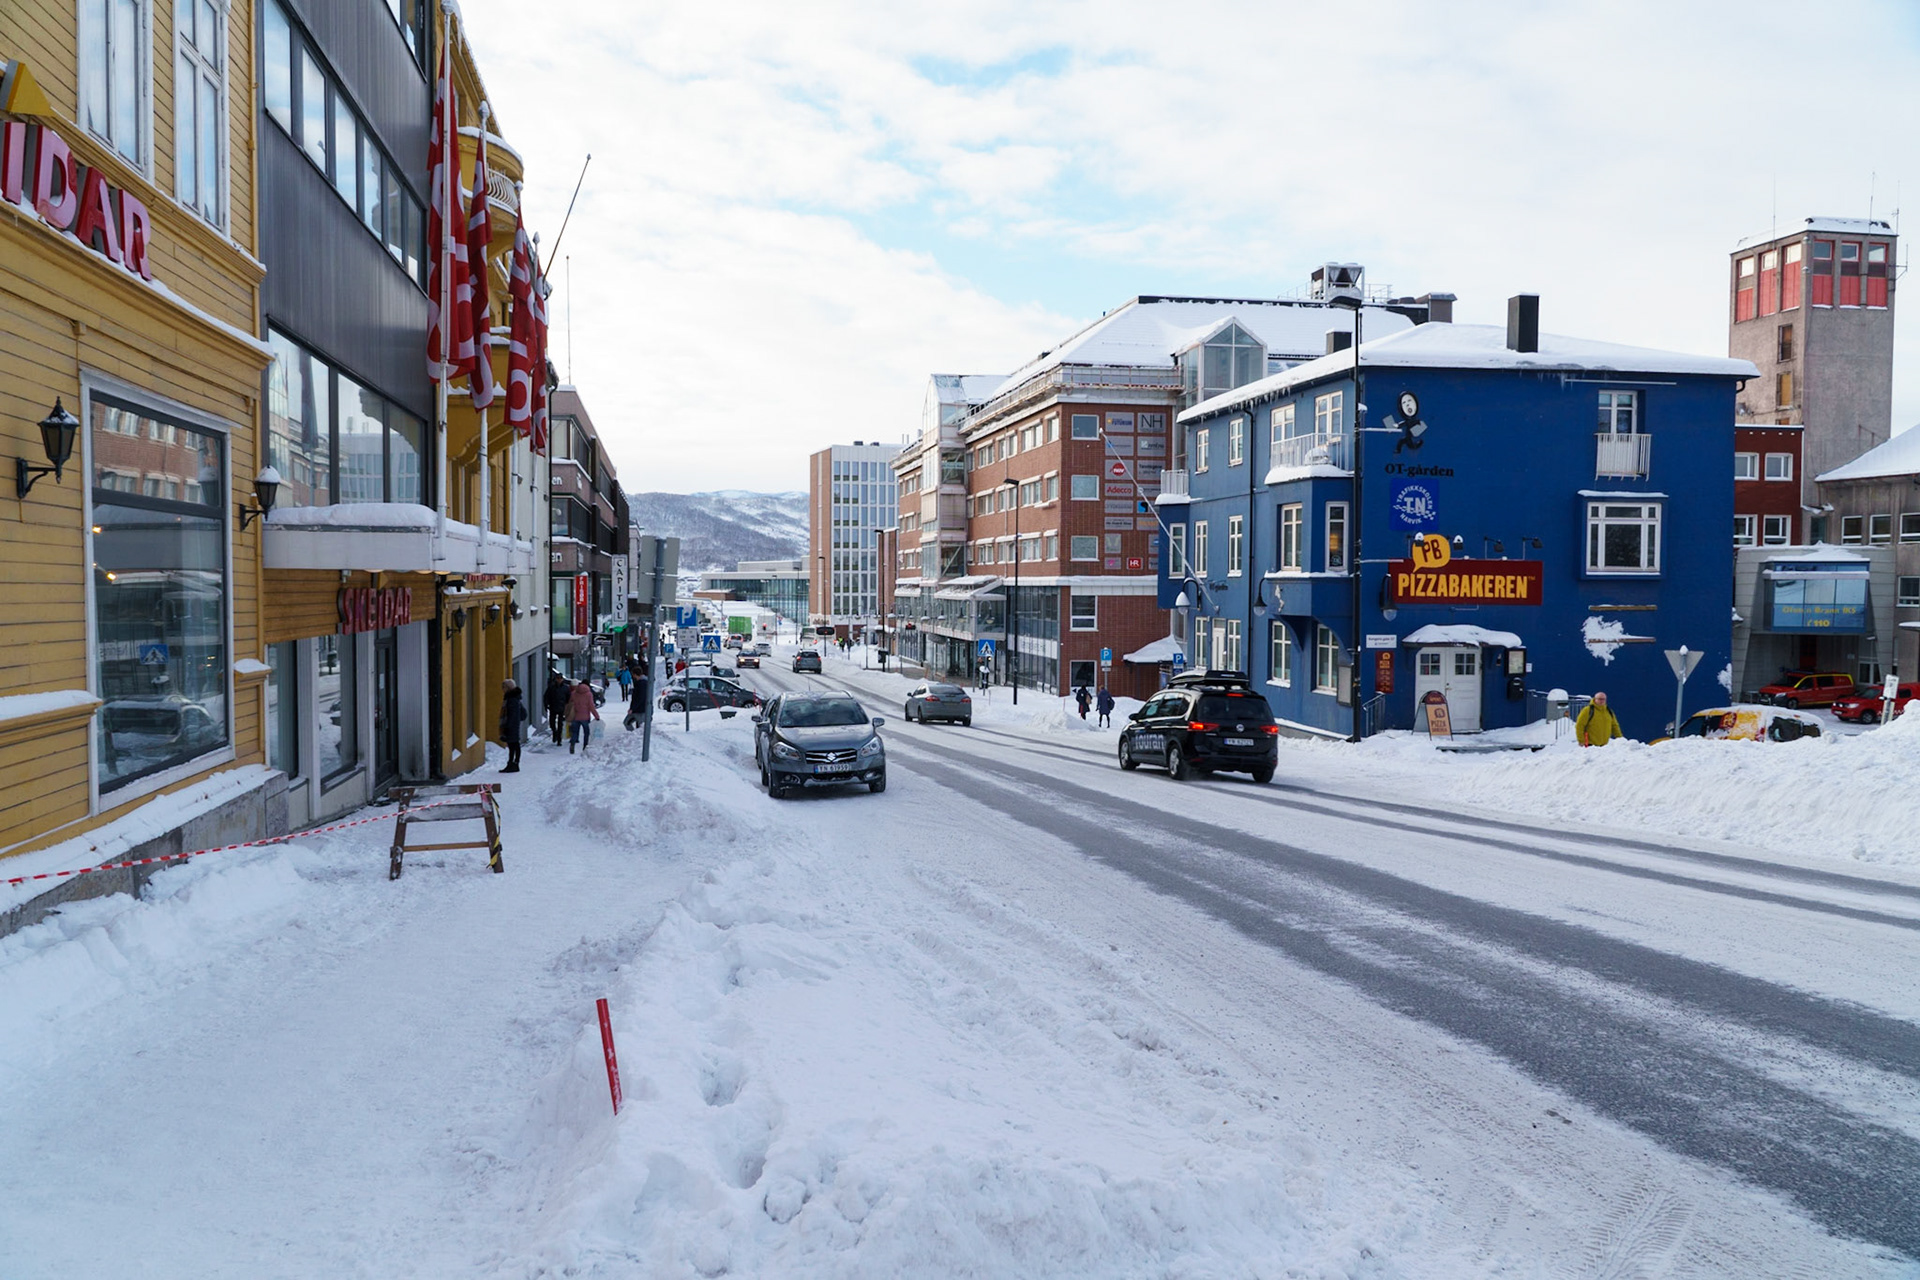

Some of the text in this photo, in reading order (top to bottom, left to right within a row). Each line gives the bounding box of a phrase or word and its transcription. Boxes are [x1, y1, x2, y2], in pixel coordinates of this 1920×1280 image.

[1141, 414, 1163, 428] NH
[1384, 463, 1454, 477] OT-gården
[1107, 486, 1132, 494] Adecco
[1421, 539, 1442, 563] PB
[616, 559, 624, 620] CAPITOL
[1398, 573, 1528, 599] PIZZABAKEREN
[342, 587, 412, 636] SKEIDAR
[1813, 619, 1830, 627] 110
